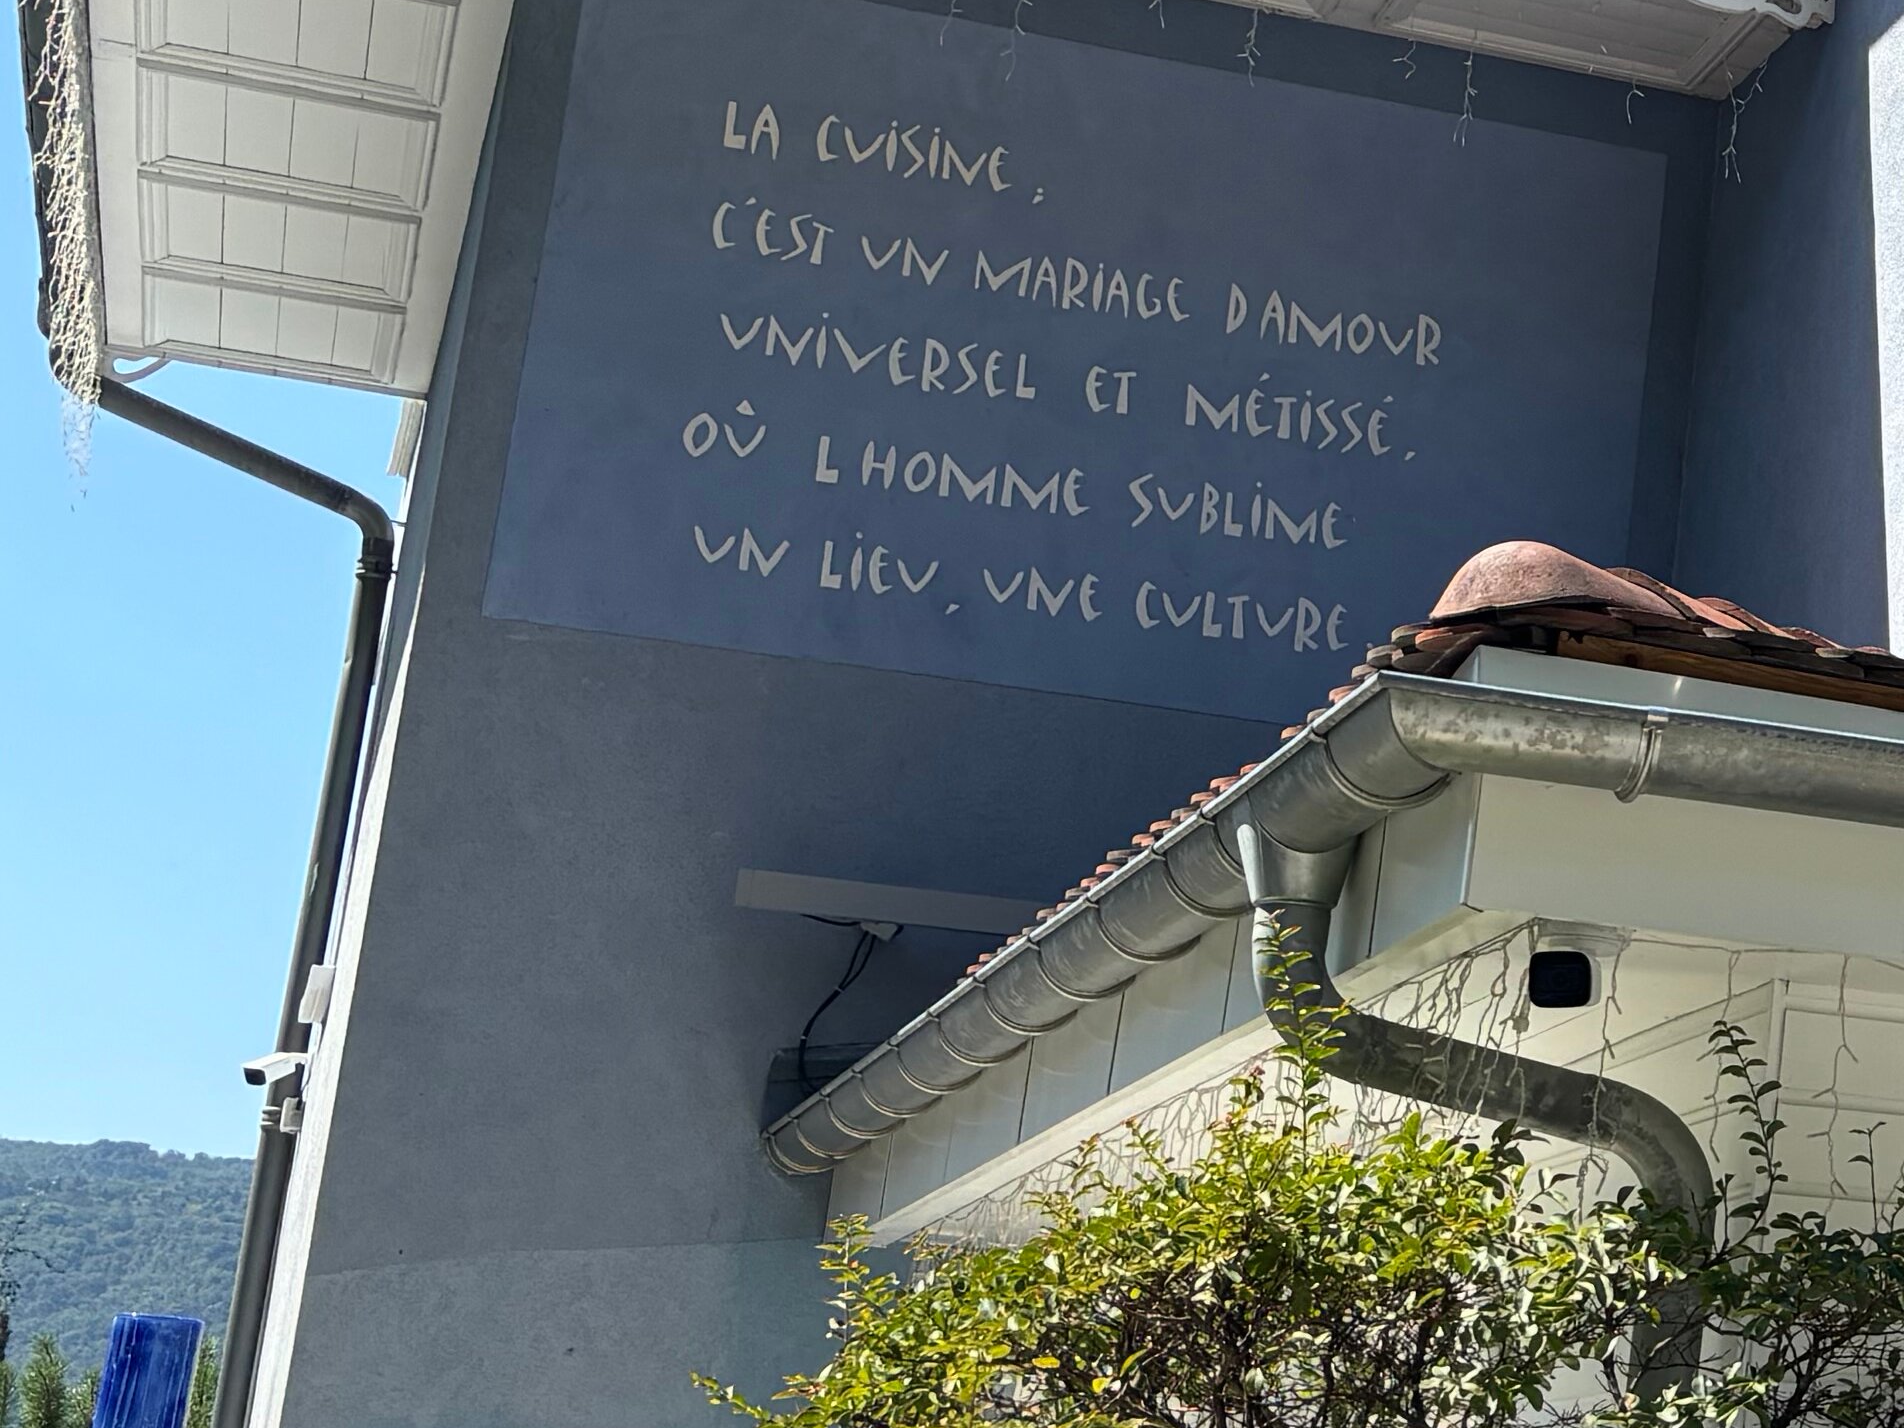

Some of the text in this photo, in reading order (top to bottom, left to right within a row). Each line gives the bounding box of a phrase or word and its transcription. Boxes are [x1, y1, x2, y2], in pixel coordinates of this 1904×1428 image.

[724, 101, 779, 160] LA
[861, 234, 949, 284] UN
[976, 250, 1189, 323] MARIAGE
[720, 312, 1036, 401] UNIVERSEL
[1086, 365, 1138, 415] ET
[1129, 472, 1350, 550] SUBLIME
[694, 524, 790, 578] UN
[983, 565, 1101, 624] UNE
